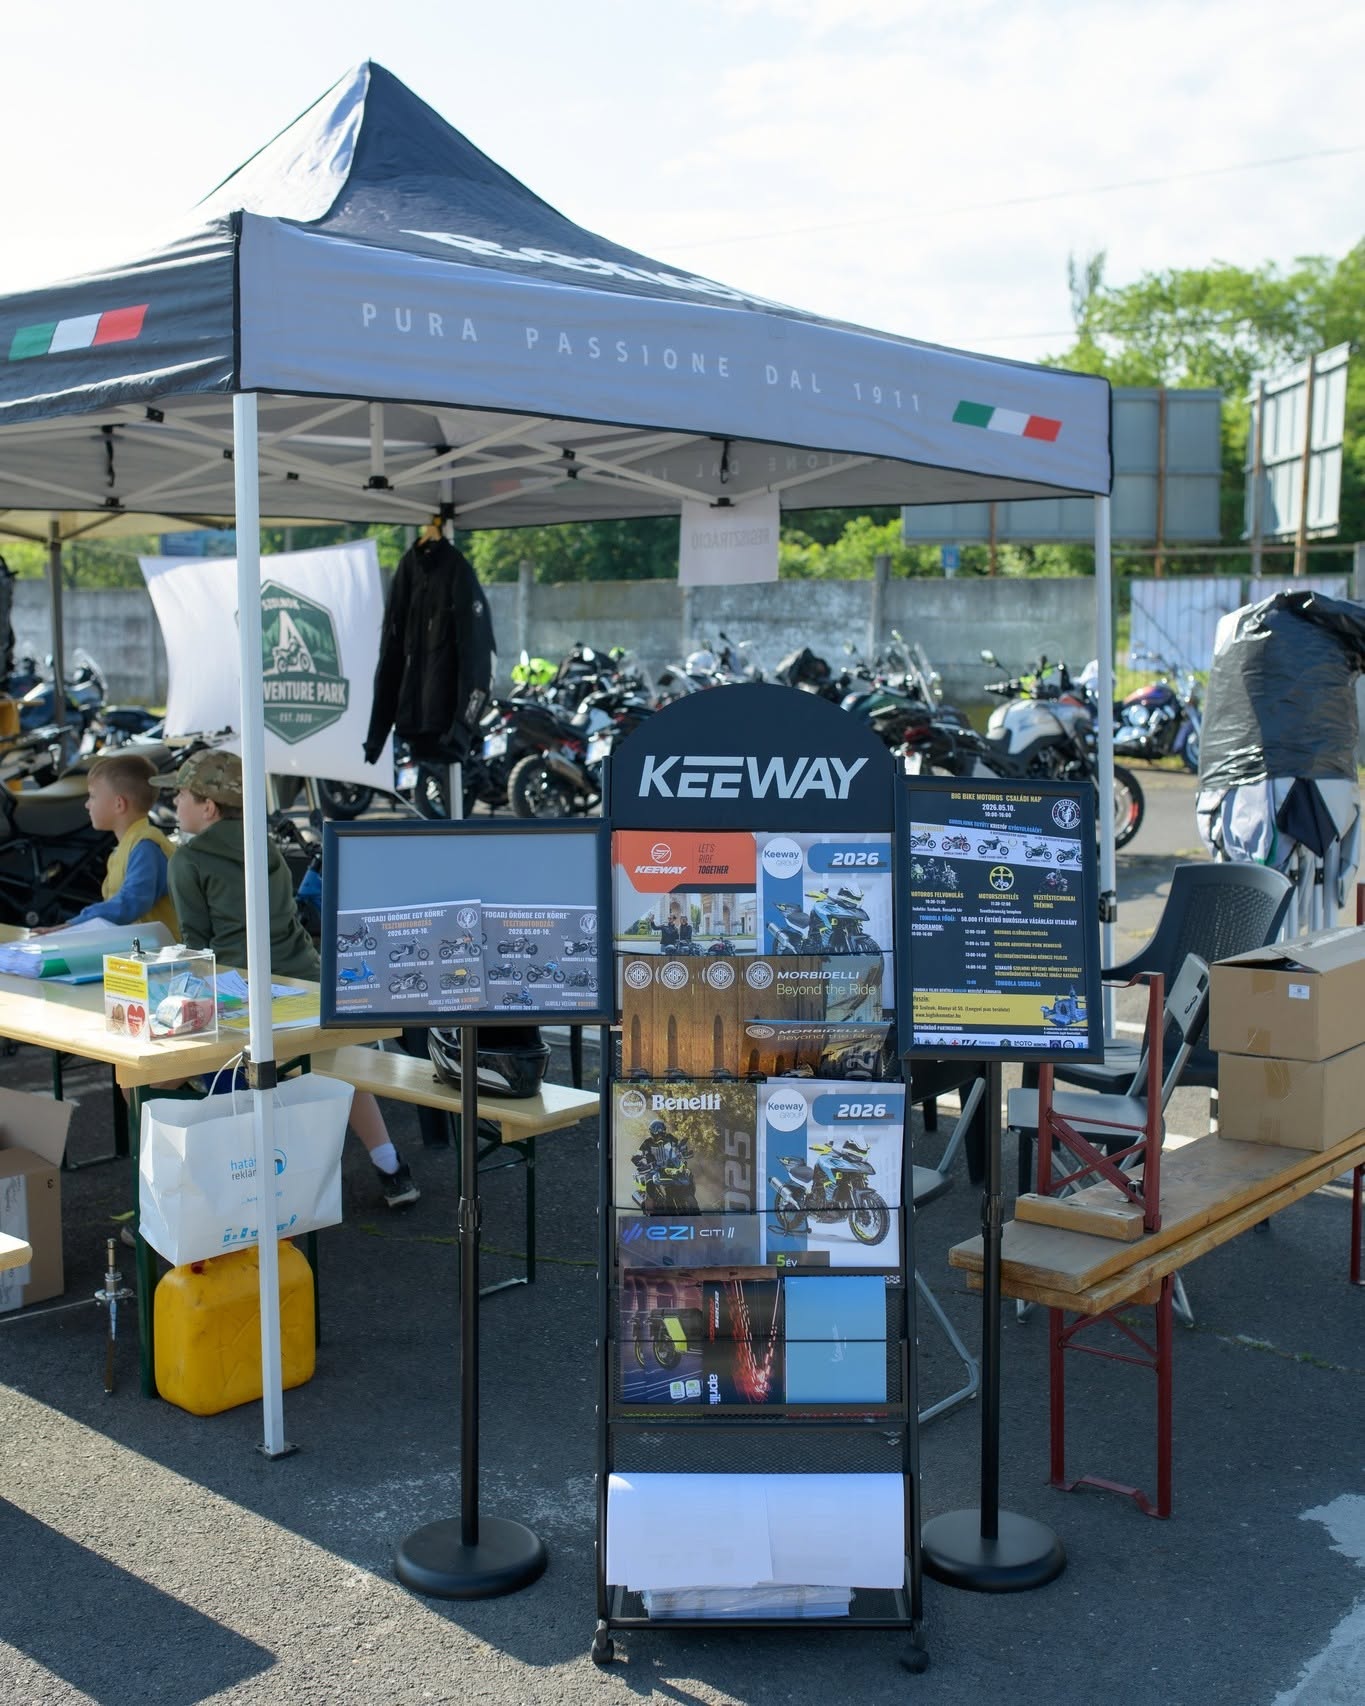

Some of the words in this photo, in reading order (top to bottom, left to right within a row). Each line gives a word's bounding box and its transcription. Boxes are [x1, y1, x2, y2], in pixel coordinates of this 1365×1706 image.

[361, 302, 478, 343] PURA
[525, 327, 730, 378] PASSIONE
[765, 364, 821, 393] DAL
[854, 382, 919, 412] 1911
[263, 681, 315, 702] VENTURE
[316, 682, 346, 704] PARK
[638, 755, 870, 800] KEEWAY
[951, 792, 961, 800] BIG
[962, 793, 976, 801] BIKE
[976, 793, 1004, 802] MOTOROS
[982, 803, 1016, 812] 2026.05.10.
[697, 854, 714, 864] RIDE
[763, 849, 800, 860] Keeway
[831, 852, 880, 867] 2026
[634, 865, 687, 875] KEEWAY
[697, 865, 729, 875] TOGETHER
[534, 911, 546, 919] EGY
[777, 970, 860, 980] MORBIDELLI
[776, 983, 822, 998] Beyond
[825, 983, 846, 995] the
[849, 982, 877, 995] Ride
[776, 1033, 824, 1041] Beyond
[651, 1092, 721, 1111] Benelli
[767, 1101, 804, 1113] Keeway
[837, 1103, 887, 1118] 2026
[779, 1111, 805, 1119] GROUP
[700, 1228, 725, 1237] CITI
